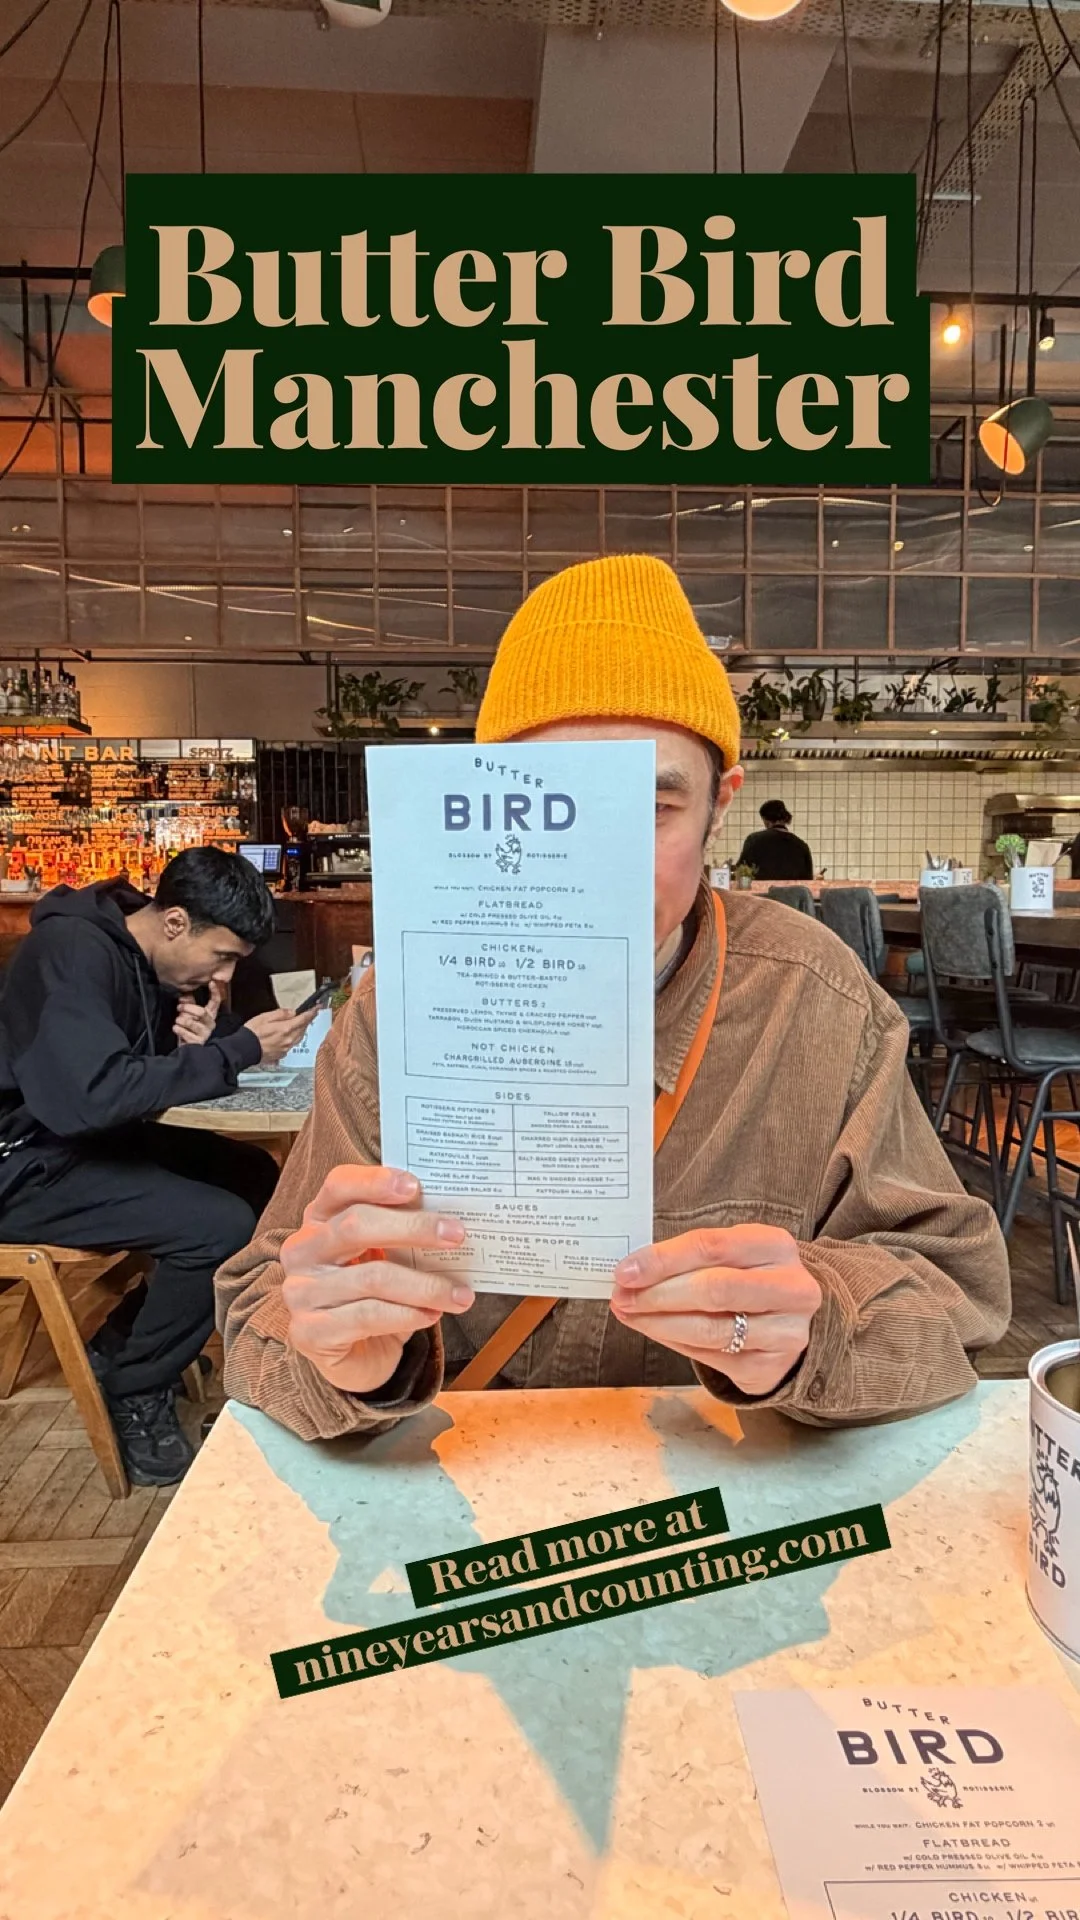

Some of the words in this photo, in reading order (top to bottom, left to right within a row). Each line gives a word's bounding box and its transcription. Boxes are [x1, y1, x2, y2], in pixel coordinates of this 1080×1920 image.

[85, 746, 134, 761] BAR
[190, 747, 234, 758] SPRITZ
[474, 757, 544, 788] BUTTER
[179, 806, 240, 816] SPECIALS
[444, 793, 576, 832] BIRD
[116, 812, 137, 821] RED
[478, 900, 543, 909] FLATBREAD
[481, 943, 535, 953] CHICKEN
[439, 954, 457, 966] 1/4
[464, 956, 496, 968] BIRD
[516, 957, 536, 969] 1/2
[542, 959, 576, 970] BIRD
[482, 998, 538, 1008] BUTTERS
[472, 1042, 495, 1051] NOT
[500, 1044, 554, 1054] CHICKEN
[444, 1053, 504, 1064] CHARGRILLED
[509, 1057, 562, 1066] AUBERGINE
[495, 1092, 531, 1101] SIDES
[500, 1235, 530, 1243] DONE
[862, 1697, 950, 1724] BUTTER
[836, 1729, 1004, 1765] BIRD
[923, 1839, 1010, 1848] FLATBREAD
[948, 1892, 1026, 1902] CHICKEN
